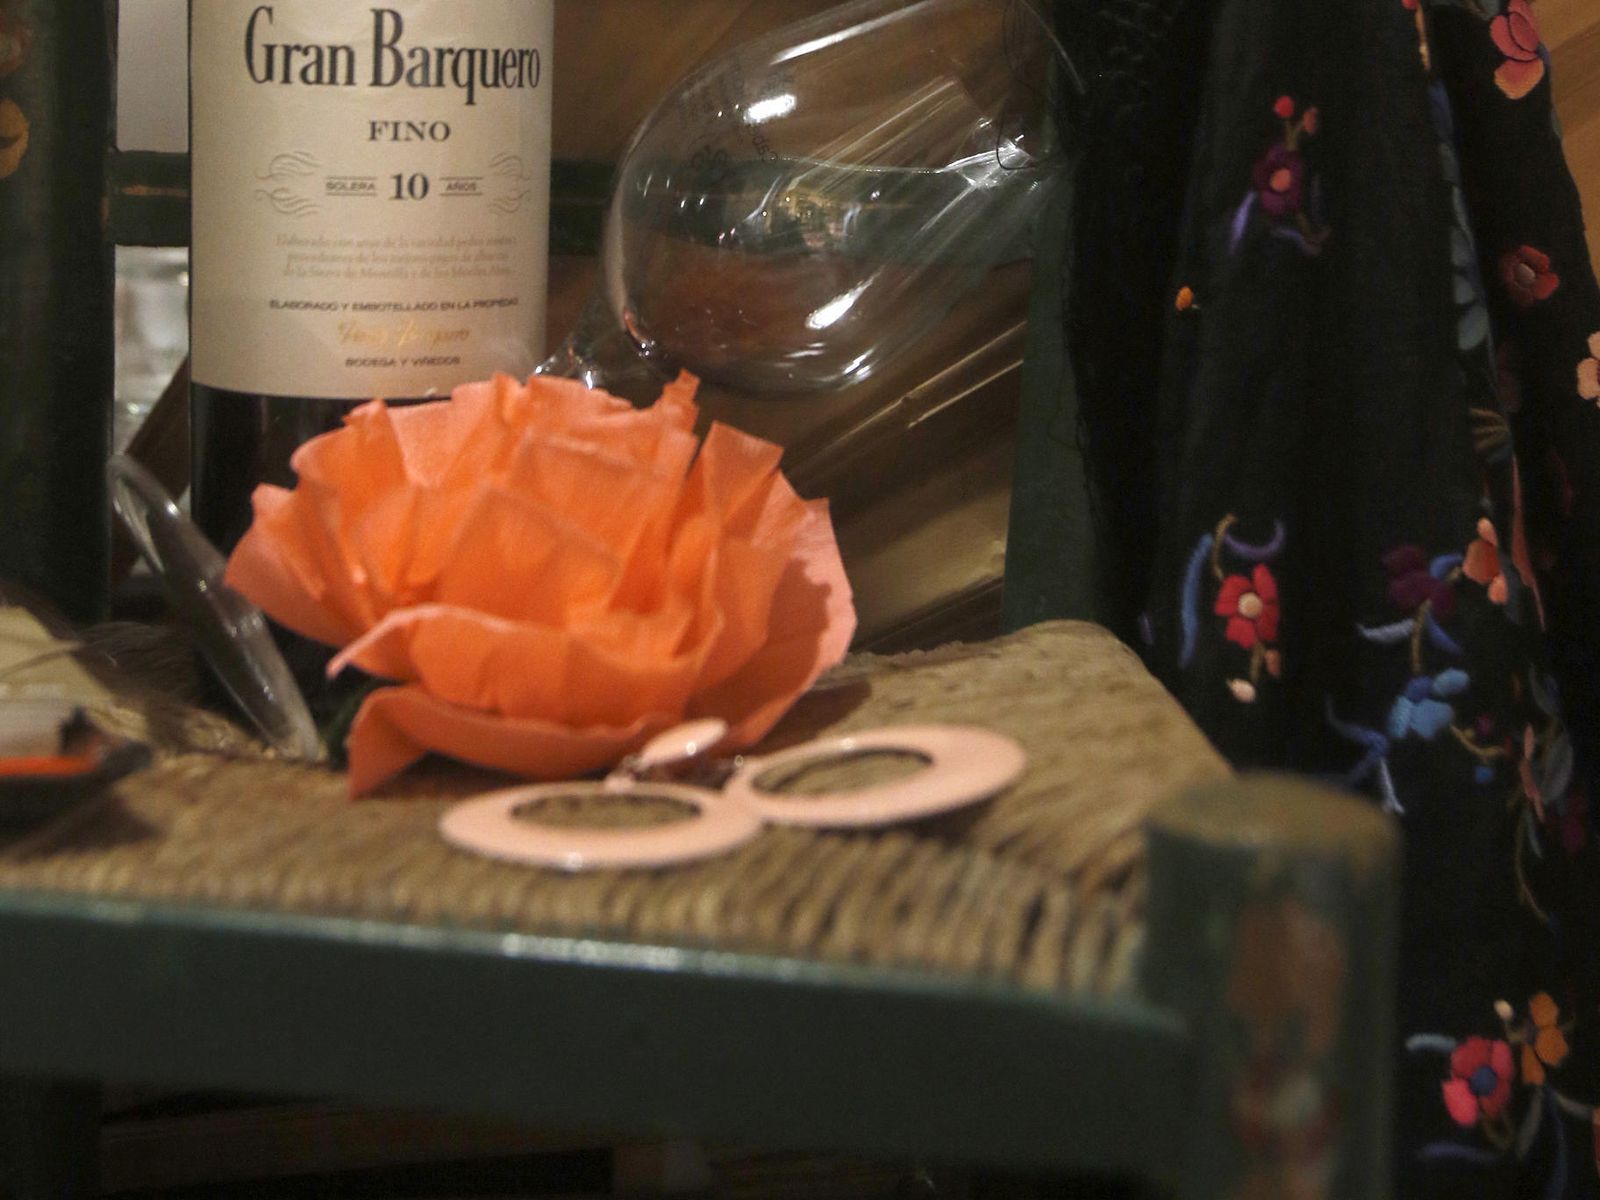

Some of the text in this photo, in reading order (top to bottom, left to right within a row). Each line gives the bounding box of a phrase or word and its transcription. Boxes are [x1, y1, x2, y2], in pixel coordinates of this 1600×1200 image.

[245, 5, 541, 106] Gran Barquero
[368, 120, 451, 142] FINO
[325, 181, 376, 192] SOLERA
[388, 172, 430, 201] 10
[269, 300, 338, 312] ELABORADO
[352, 302, 438, 313] EMBOTELLADO
[345, 357, 396, 368] BODEGA
